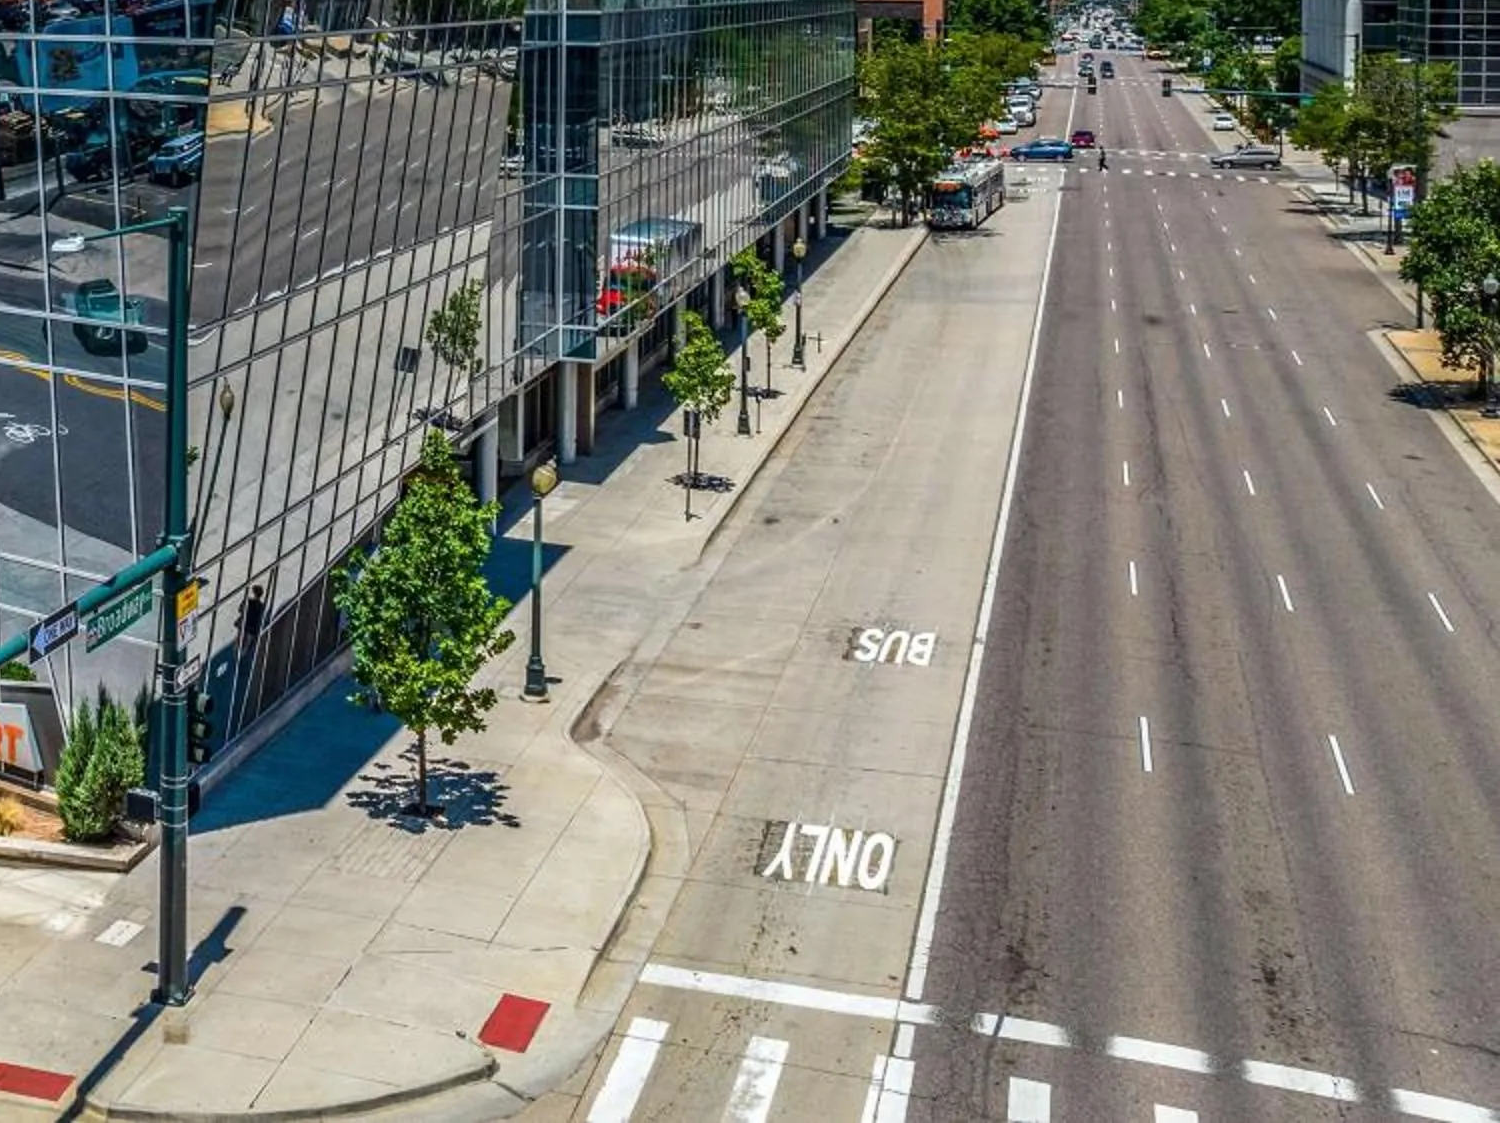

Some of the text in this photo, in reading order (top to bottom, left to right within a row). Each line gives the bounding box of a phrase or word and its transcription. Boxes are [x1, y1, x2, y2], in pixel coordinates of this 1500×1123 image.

[44, 624, 60, 644] ONE
[60, 613, 74, 633] WAY
[97, 596, 144, 636] Broadway
[854, 628, 936, 666] BUS
[763, 821, 895, 890] ONLY
